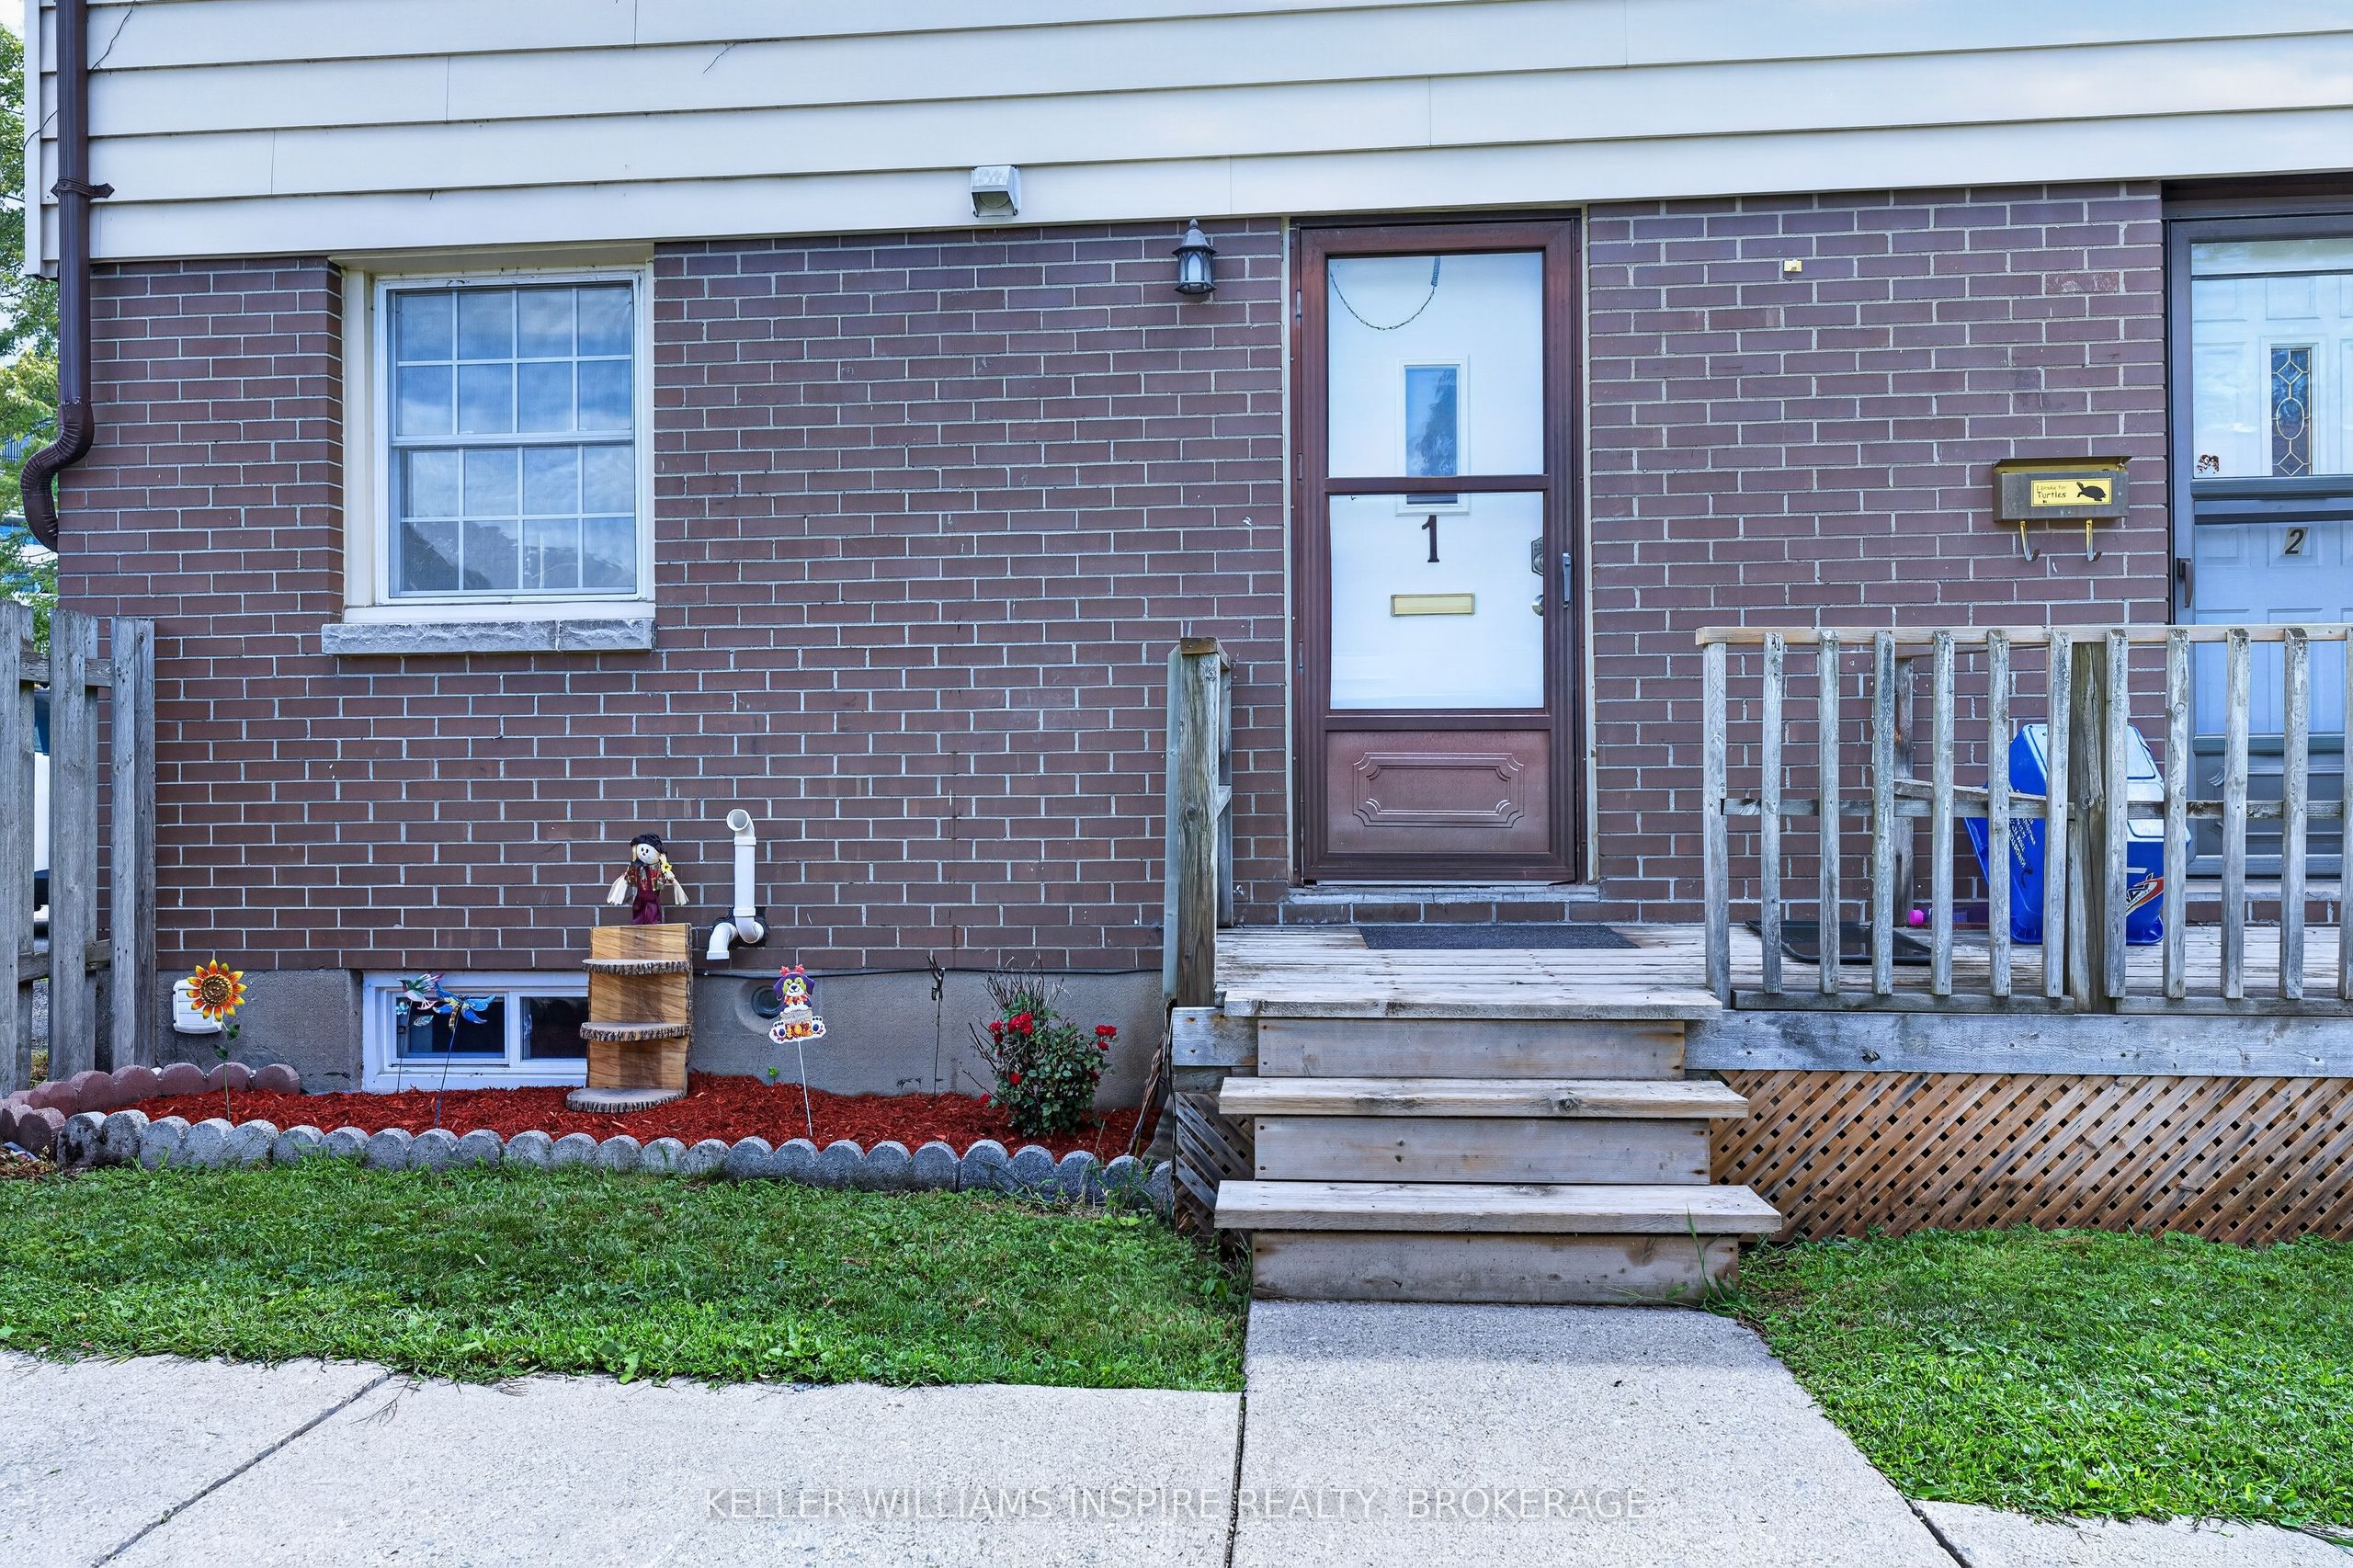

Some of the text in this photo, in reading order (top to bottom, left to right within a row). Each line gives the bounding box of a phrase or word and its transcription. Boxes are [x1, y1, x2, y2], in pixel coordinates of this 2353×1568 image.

[2036, 491, 2067, 499] Turtles
[1421, 514, 1440, 563] 1
[2284, 528, 2305, 555] 2
